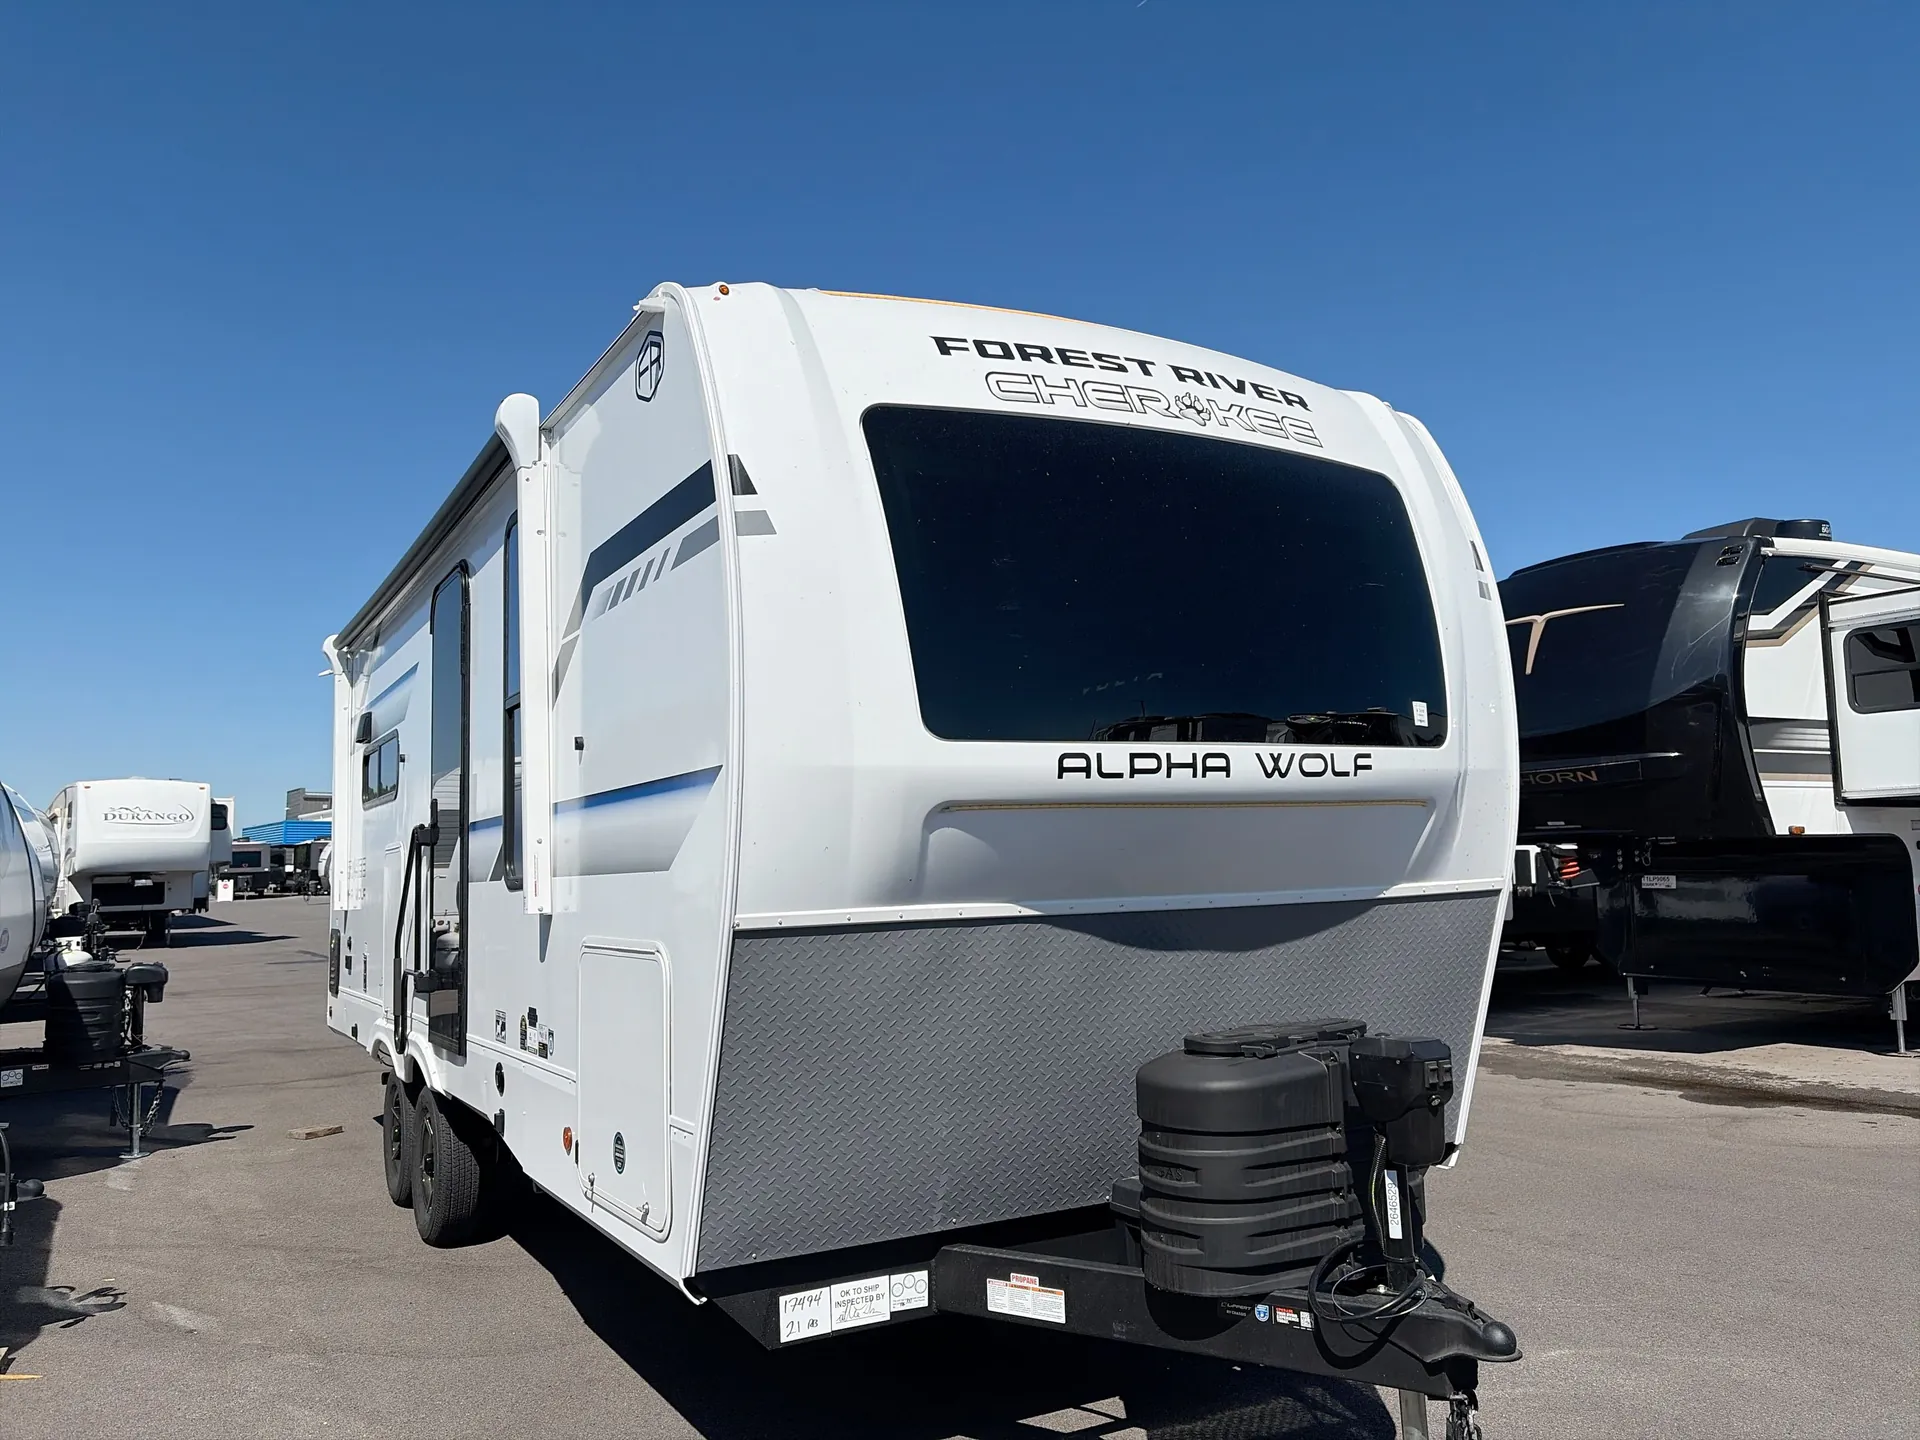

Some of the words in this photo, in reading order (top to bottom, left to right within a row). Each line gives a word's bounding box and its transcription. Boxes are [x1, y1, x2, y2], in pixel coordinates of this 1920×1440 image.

[928, 335, 1157, 378] FOREST
[1166, 363, 1312, 412] RIVER
[1057, 752, 1231, 779] ALPHA
[1254, 752, 1373, 779] WOLF
[103, 812, 190, 822] DURANGO
[1387, 1182, 1400, 1226] 2646529
[1011, 1274, 1038, 1286] PROPANE
[839, 1288, 852, 1298] OK
[853, 1286, 862, 1295] TO
[863, 1284, 880, 1293] SHIP
[834, 1295, 874, 1309] INSPECTED
[875, 1292, 886, 1301] BY
